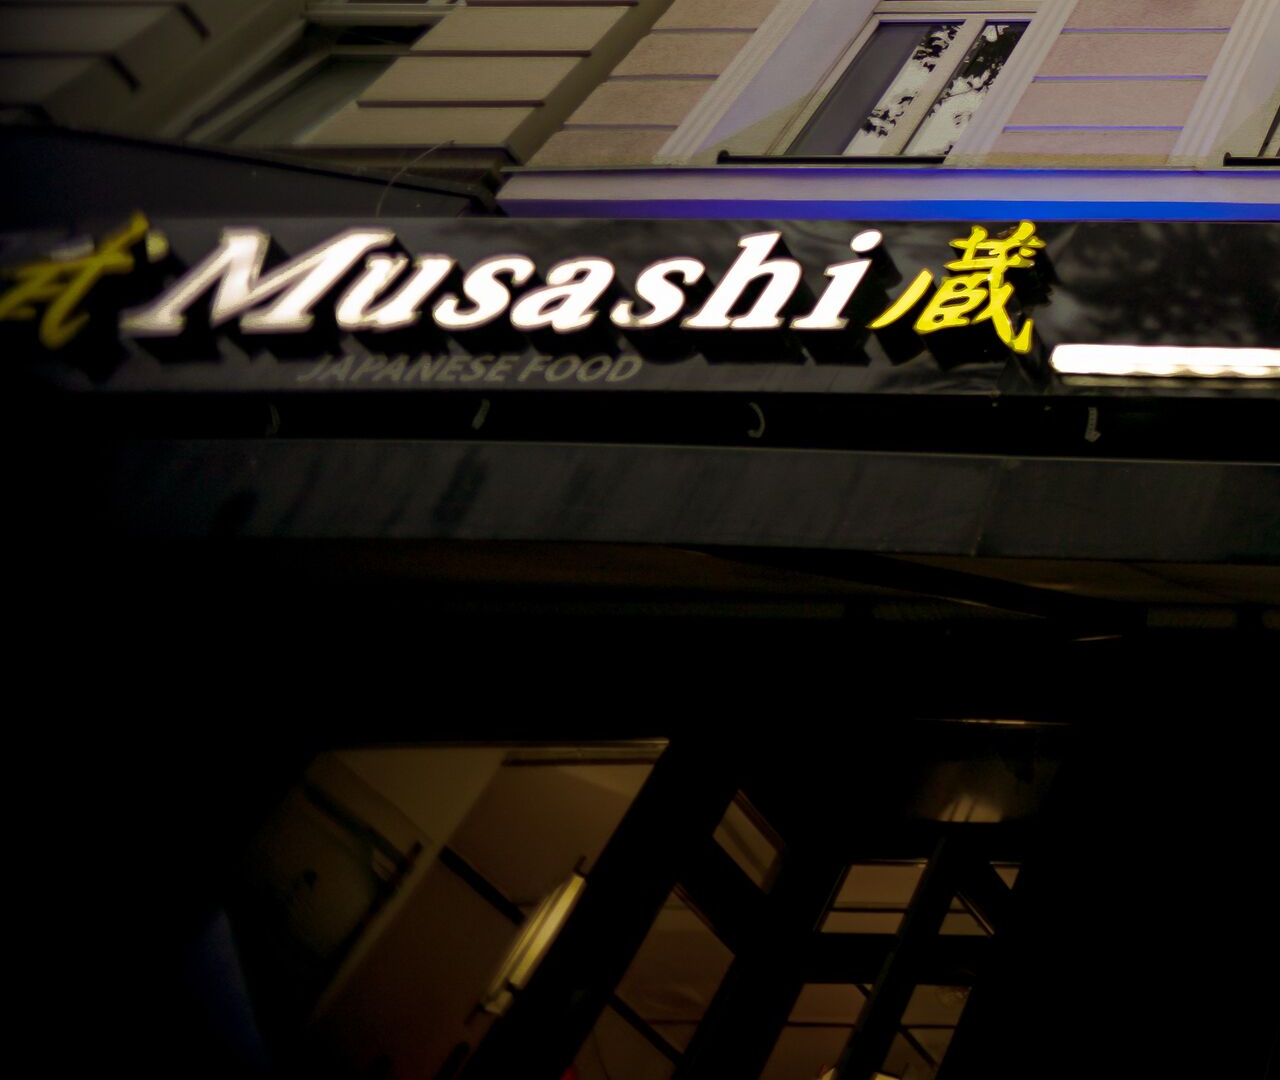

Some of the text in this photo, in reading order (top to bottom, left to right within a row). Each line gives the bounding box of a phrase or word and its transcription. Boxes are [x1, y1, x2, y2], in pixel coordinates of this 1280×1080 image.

[120, 226, 884, 334] Musashi
[296, 353, 643, 385] JAPANESE FOOD
